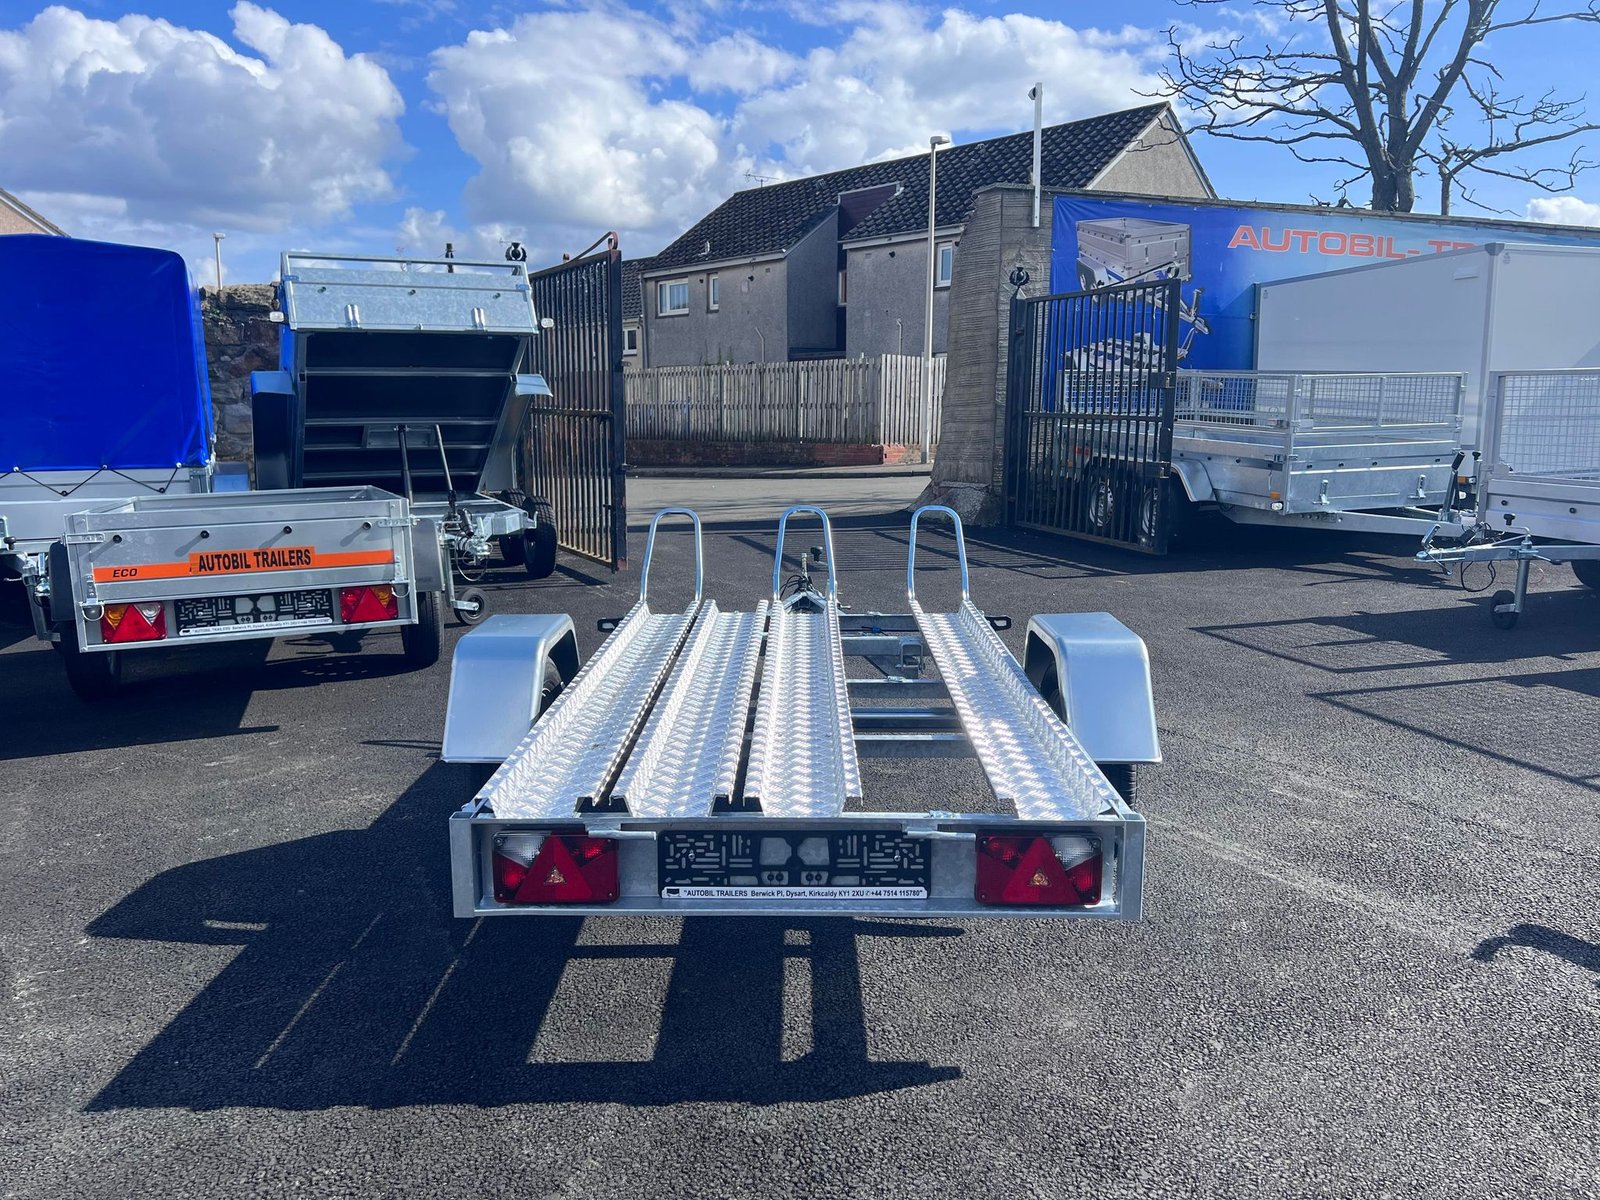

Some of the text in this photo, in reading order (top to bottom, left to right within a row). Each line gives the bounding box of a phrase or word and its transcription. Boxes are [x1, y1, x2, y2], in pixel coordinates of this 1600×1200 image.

[198, 549, 312, 572] AUTOBIL TRAILERS
[112, 568, 138, 578] ECO
[716, 889, 748, 897] TRAILERS
[750, 889, 775, 897] Berwick
[786, 889, 807, 898] Dysart,
[808, 889, 837, 898] Kirkcaldy
[838, 889, 850, 897] KY1
[851, 889, 865, 897] 2XU
[883, 889, 898, 897] 7514
